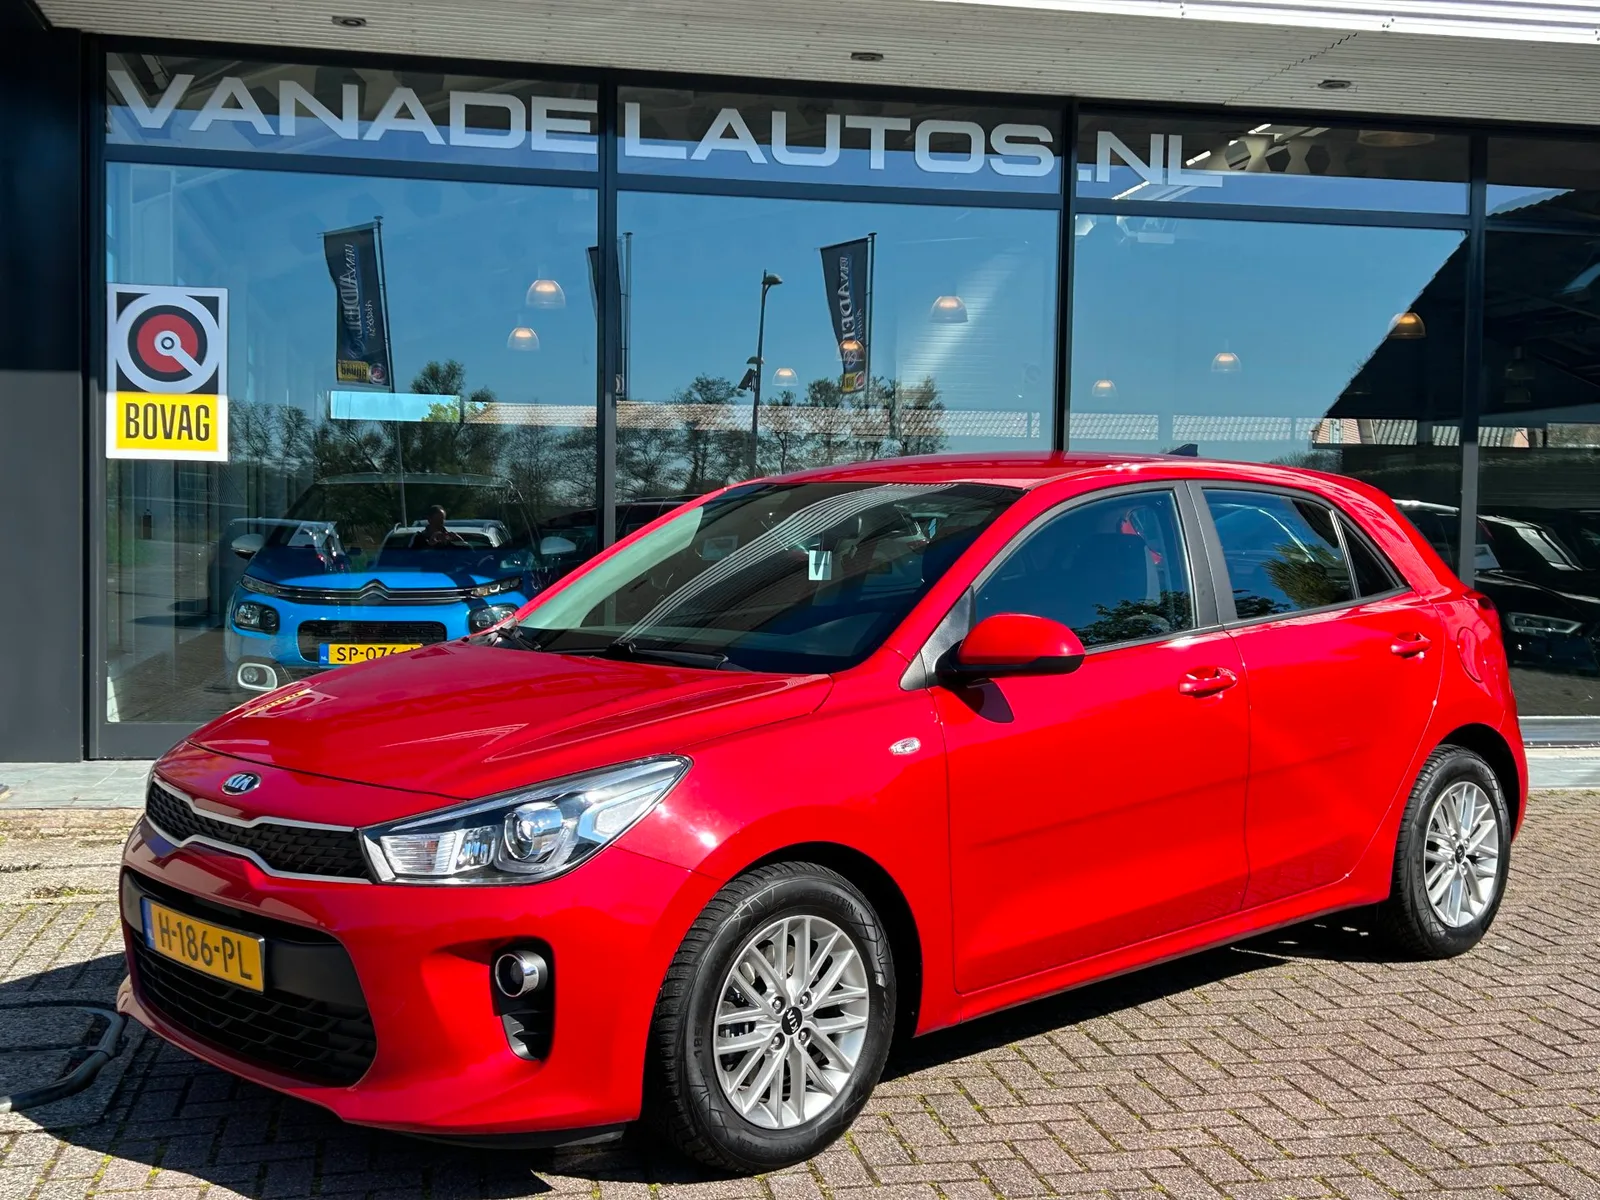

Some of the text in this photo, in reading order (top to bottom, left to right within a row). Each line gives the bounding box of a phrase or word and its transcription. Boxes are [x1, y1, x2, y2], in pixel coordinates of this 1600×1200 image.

[125, 402, 210, 442] BOVAG
[224, 773, 254, 791] KIA
[158, 911, 253, 981] H-186-PL
[786, 1009, 799, 1033] KIA
